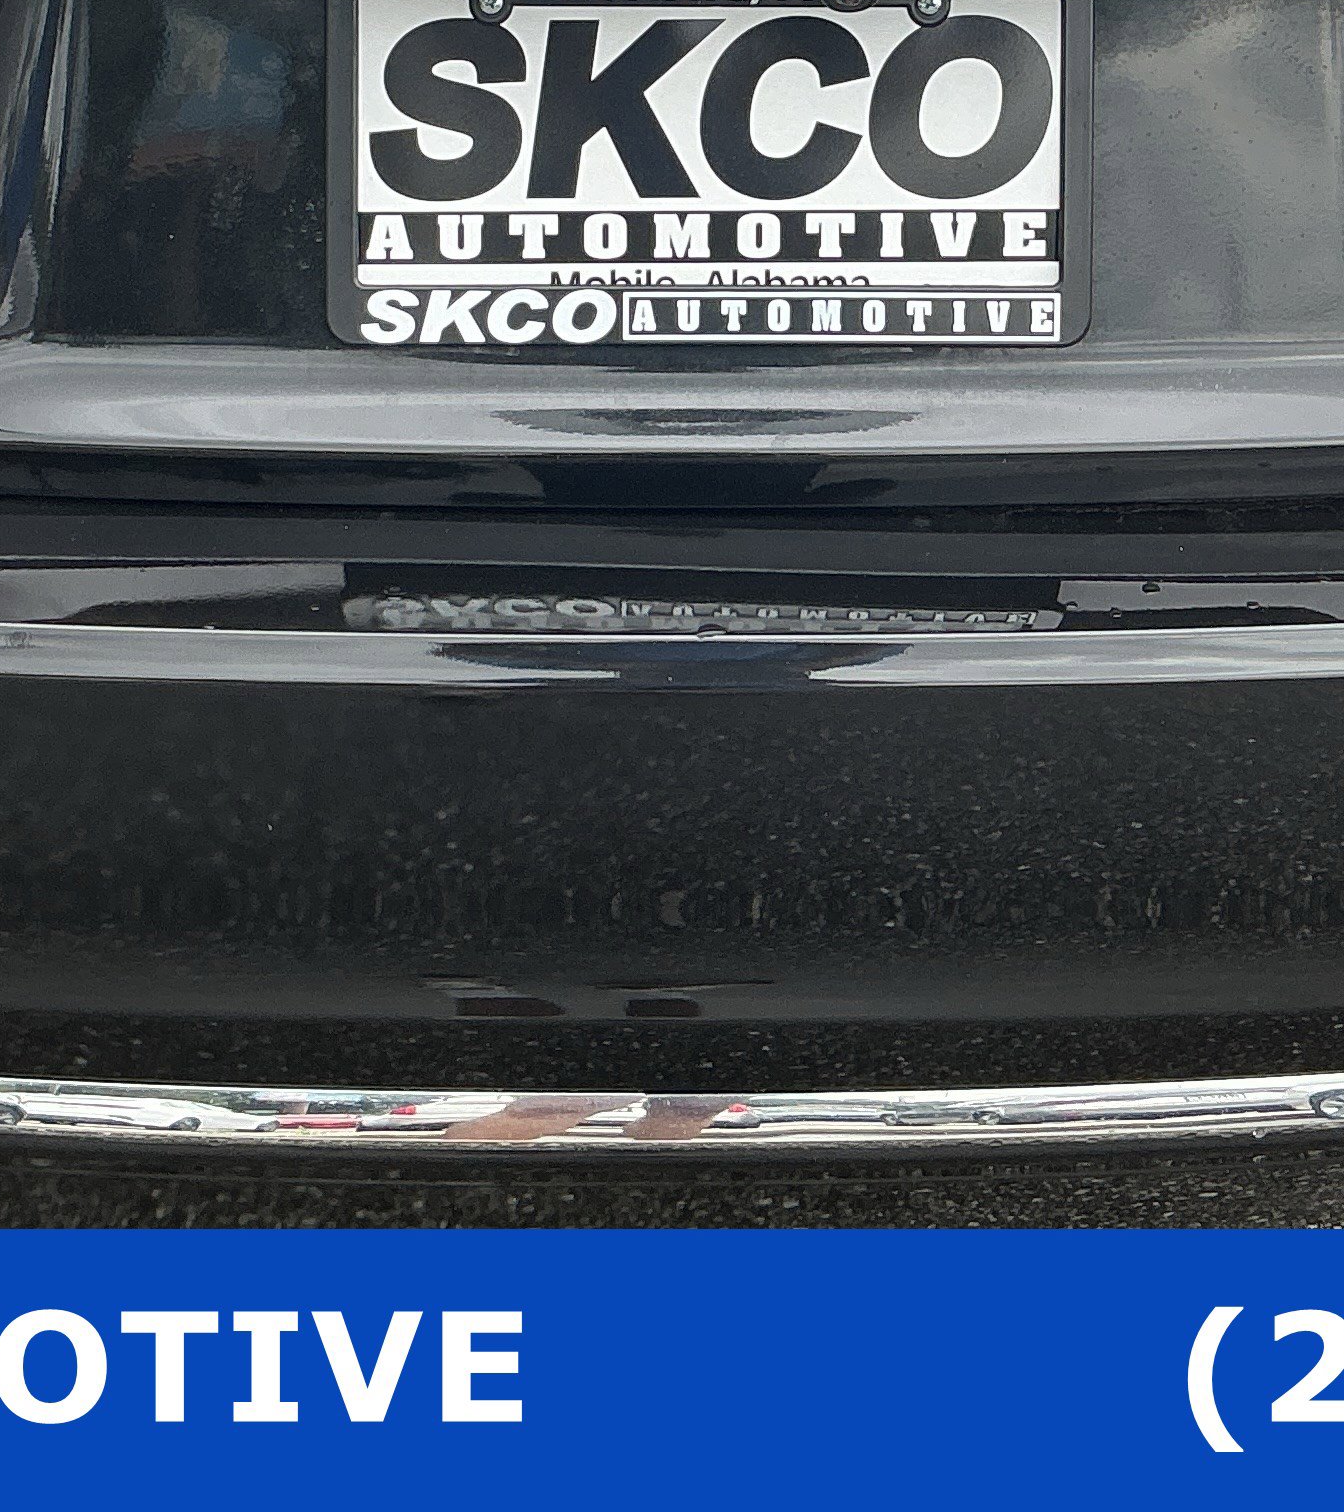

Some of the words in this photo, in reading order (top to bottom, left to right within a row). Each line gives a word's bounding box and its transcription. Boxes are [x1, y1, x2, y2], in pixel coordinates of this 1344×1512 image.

[368, 14, 1054, 203] SKCO
[365, 211, 1048, 262] AUTOMOTIVE
[360, 288, 618, 344] SKCO
[631, 298, 1056, 334] AUTOMOTIVE
